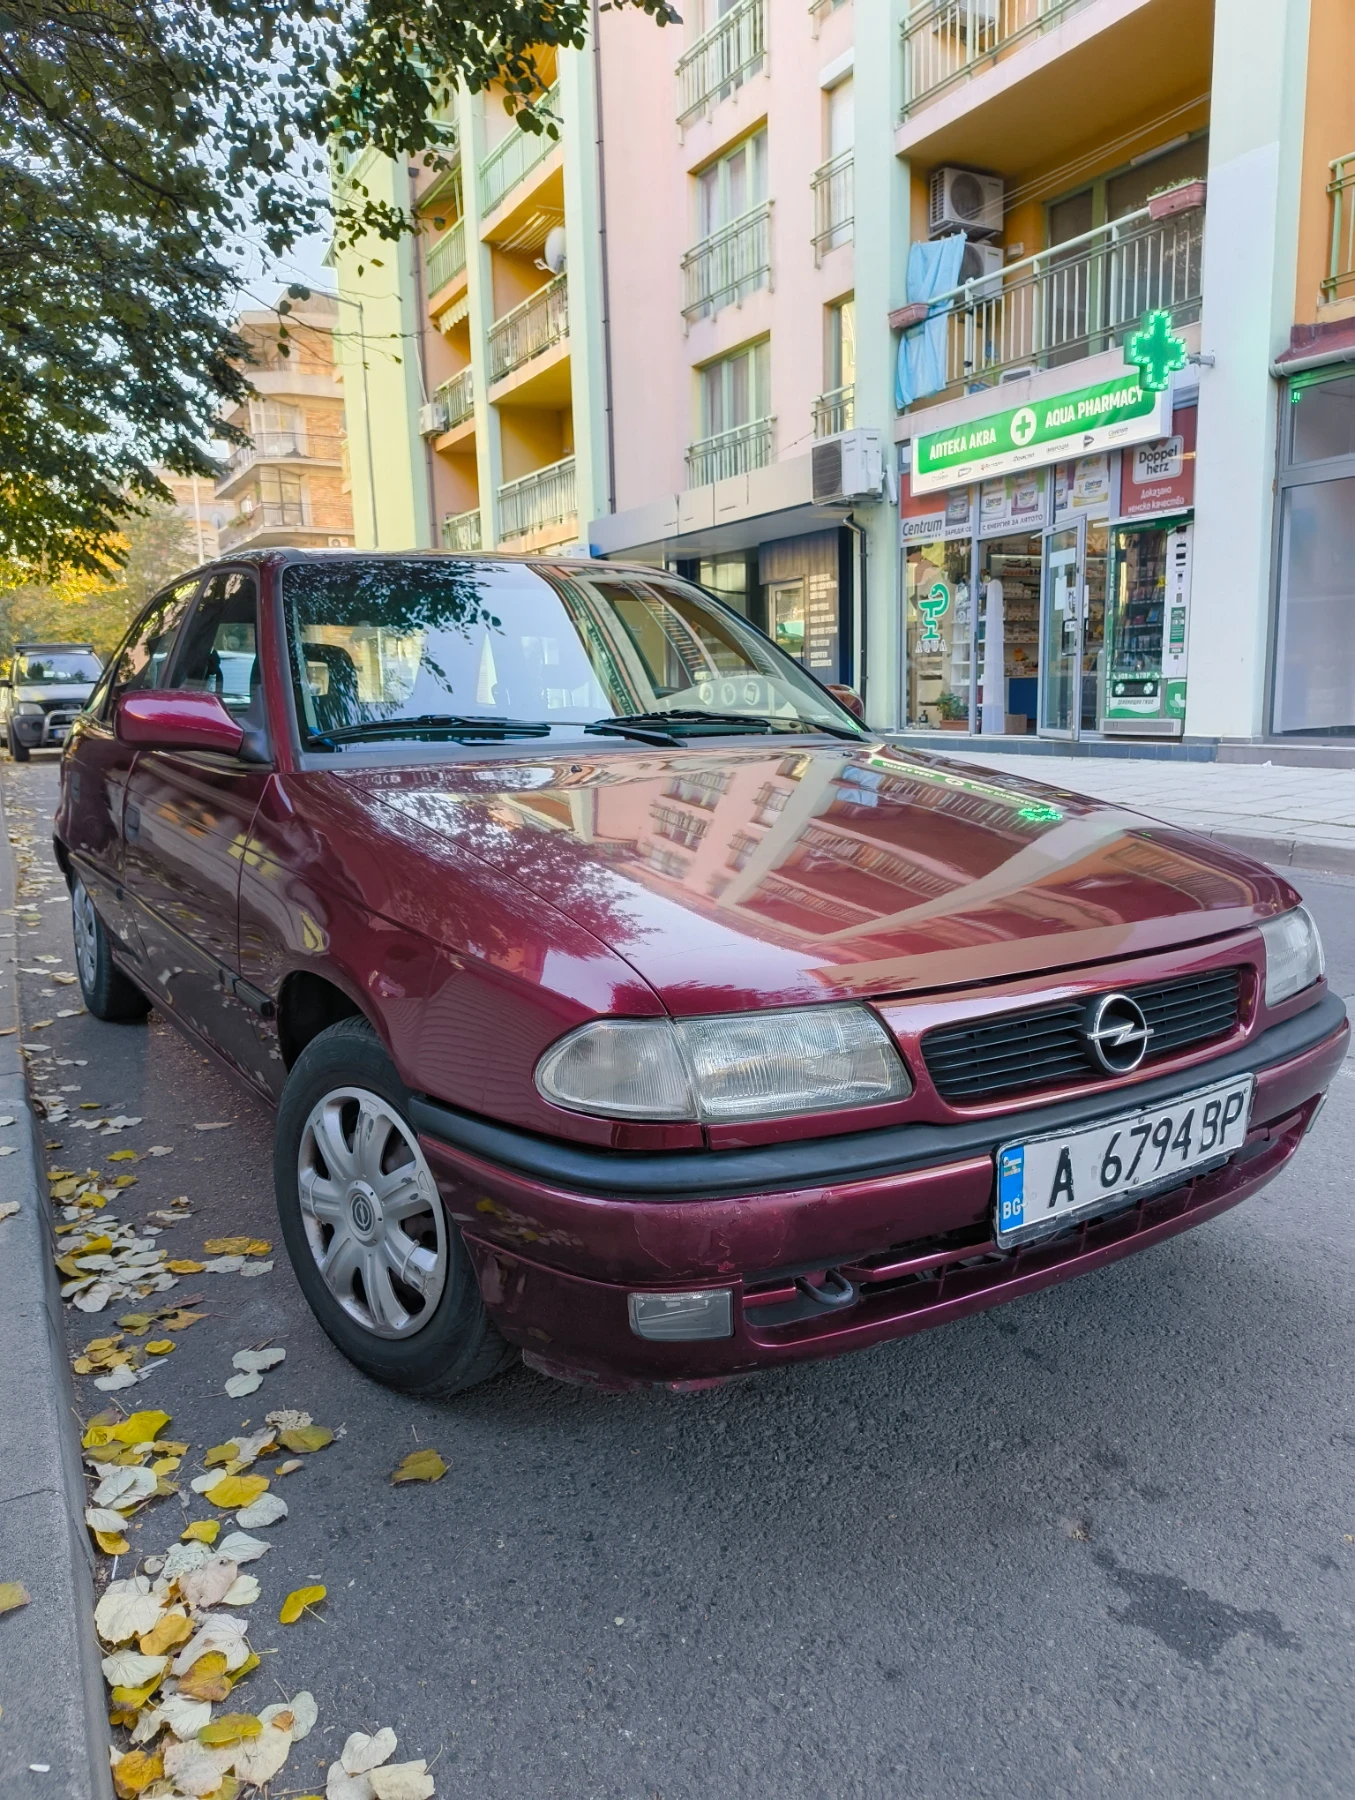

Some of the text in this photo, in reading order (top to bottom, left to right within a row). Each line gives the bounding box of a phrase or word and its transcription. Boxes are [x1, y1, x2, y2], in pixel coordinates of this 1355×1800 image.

[1045, 385, 1144, 428] AQUA PHARMACY
[929, 427, 997, 461] АПТЕКА АКВА
[1138, 445, 1178, 465] Doppel
[1146, 462, 1169, 476] herz
[1140, 486, 1172, 499] Доказано
[1127, 495, 1185, 513] немско качество
[902, 519, 943, 537] Centrum
[1011, 518, 1019, 526] ЗА
[915, 639, 948, 654] AQUA
[1047, 1090, 1244, 1209] A 6794 BP
[1002, 1197, 1022, 1220] BG
